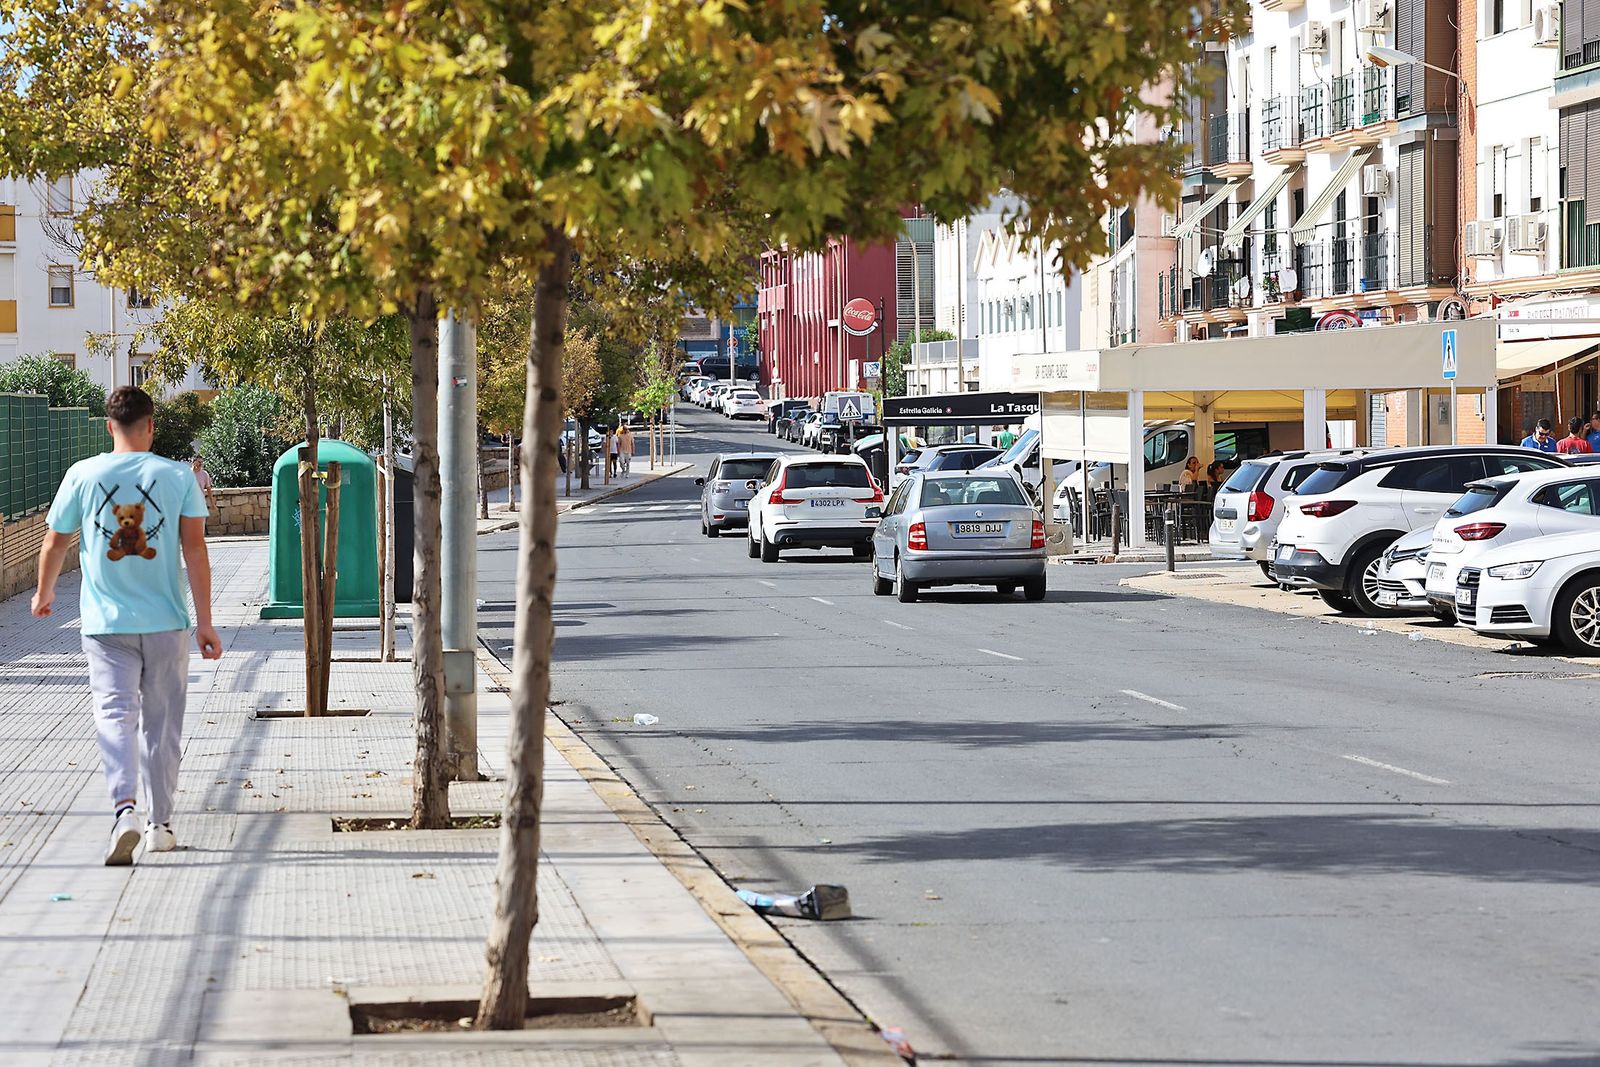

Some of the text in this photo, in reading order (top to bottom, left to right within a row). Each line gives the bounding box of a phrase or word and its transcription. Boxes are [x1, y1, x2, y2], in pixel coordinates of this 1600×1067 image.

[921, 406, 943, 414] Galicia
[990, 403, 1039, 414] La Tasqu
[960, 524, 1002, 533] 9819 DJJ
